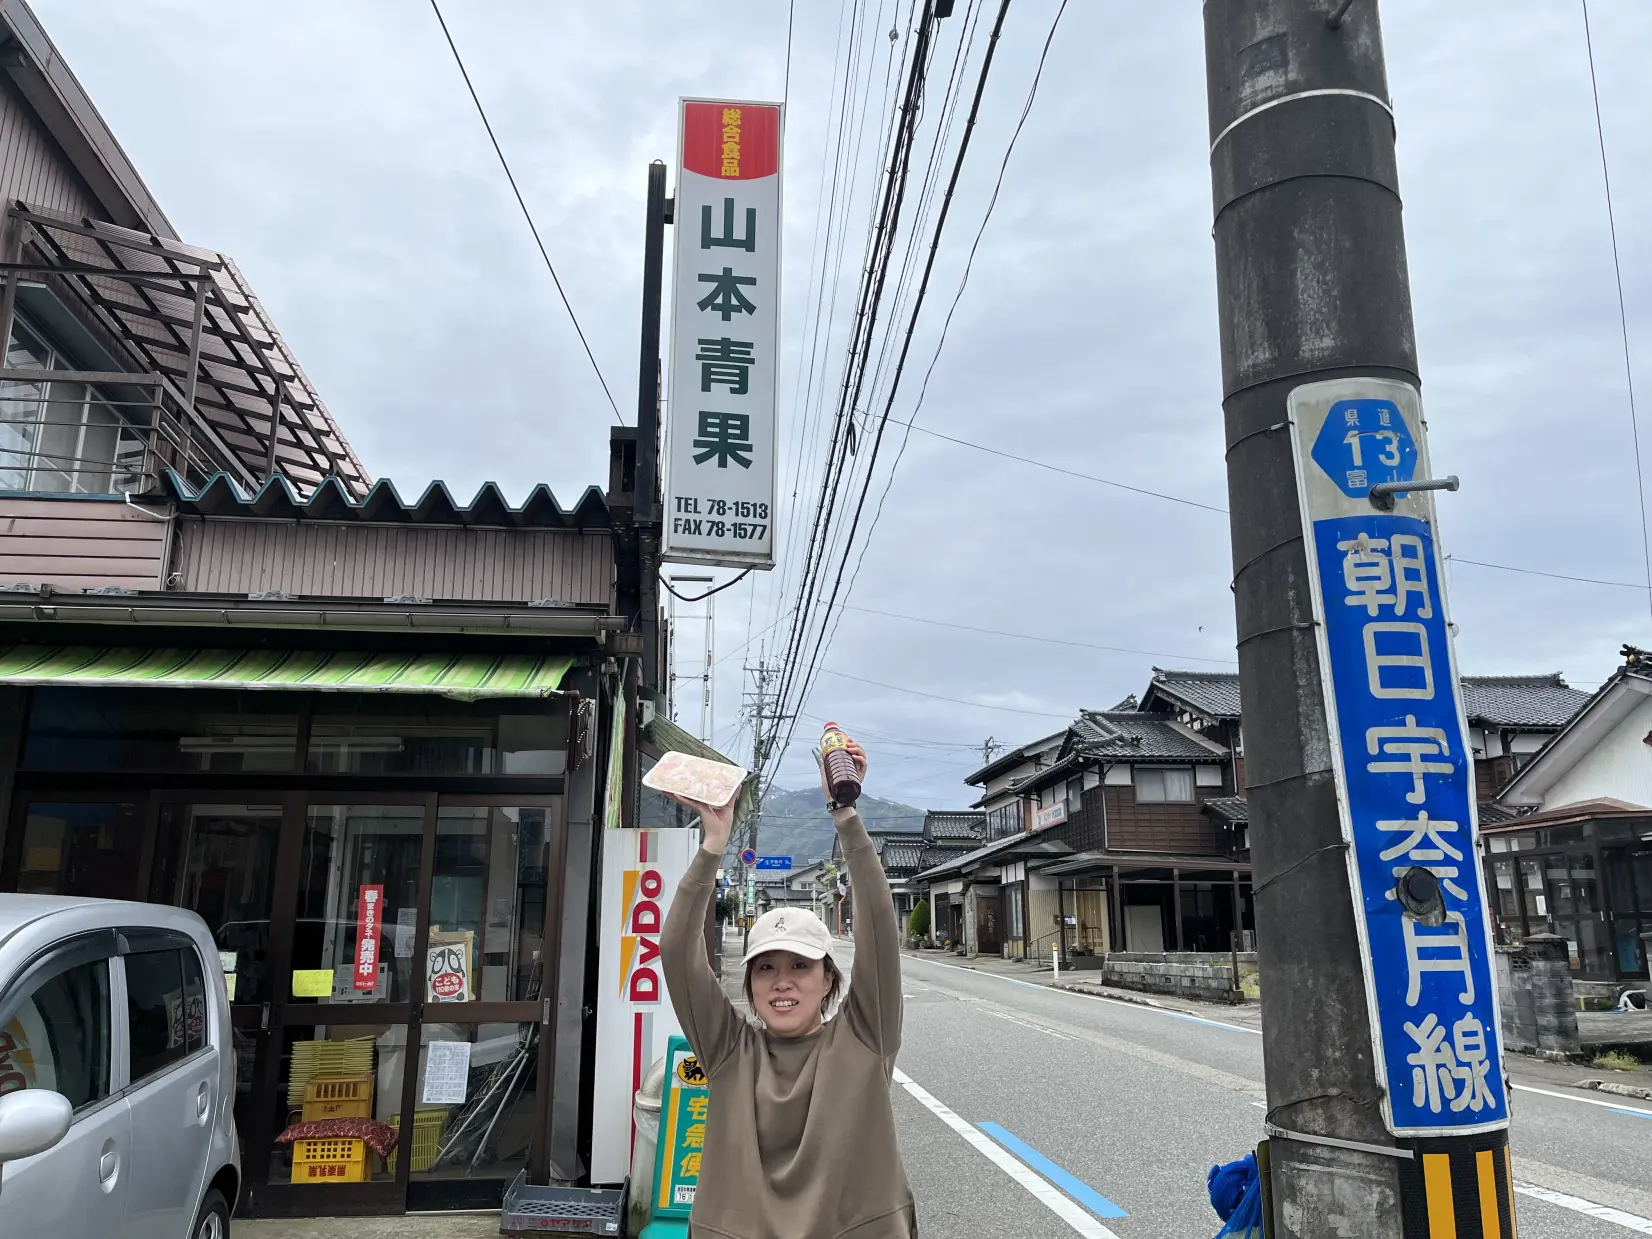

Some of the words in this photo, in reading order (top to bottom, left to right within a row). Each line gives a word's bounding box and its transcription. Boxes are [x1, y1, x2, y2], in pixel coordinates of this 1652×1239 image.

[721, 108, 742, 177] 総合食品
[692, 197, 757, 470] 山本青果
[1343, 430, 1401, 467] 13
[673, 518, 703, 535] FAX
[705, 520, 767, 540] 78-1577
[675, 496, 702, 514] TEL
[706, 499, 768, 519] 78-1513
[1337, 532, 1496, 1114] 朝日宇奈月線
[435, 975, 460, 986] こども
[679, 1096, 709, 1177] 宅急便
